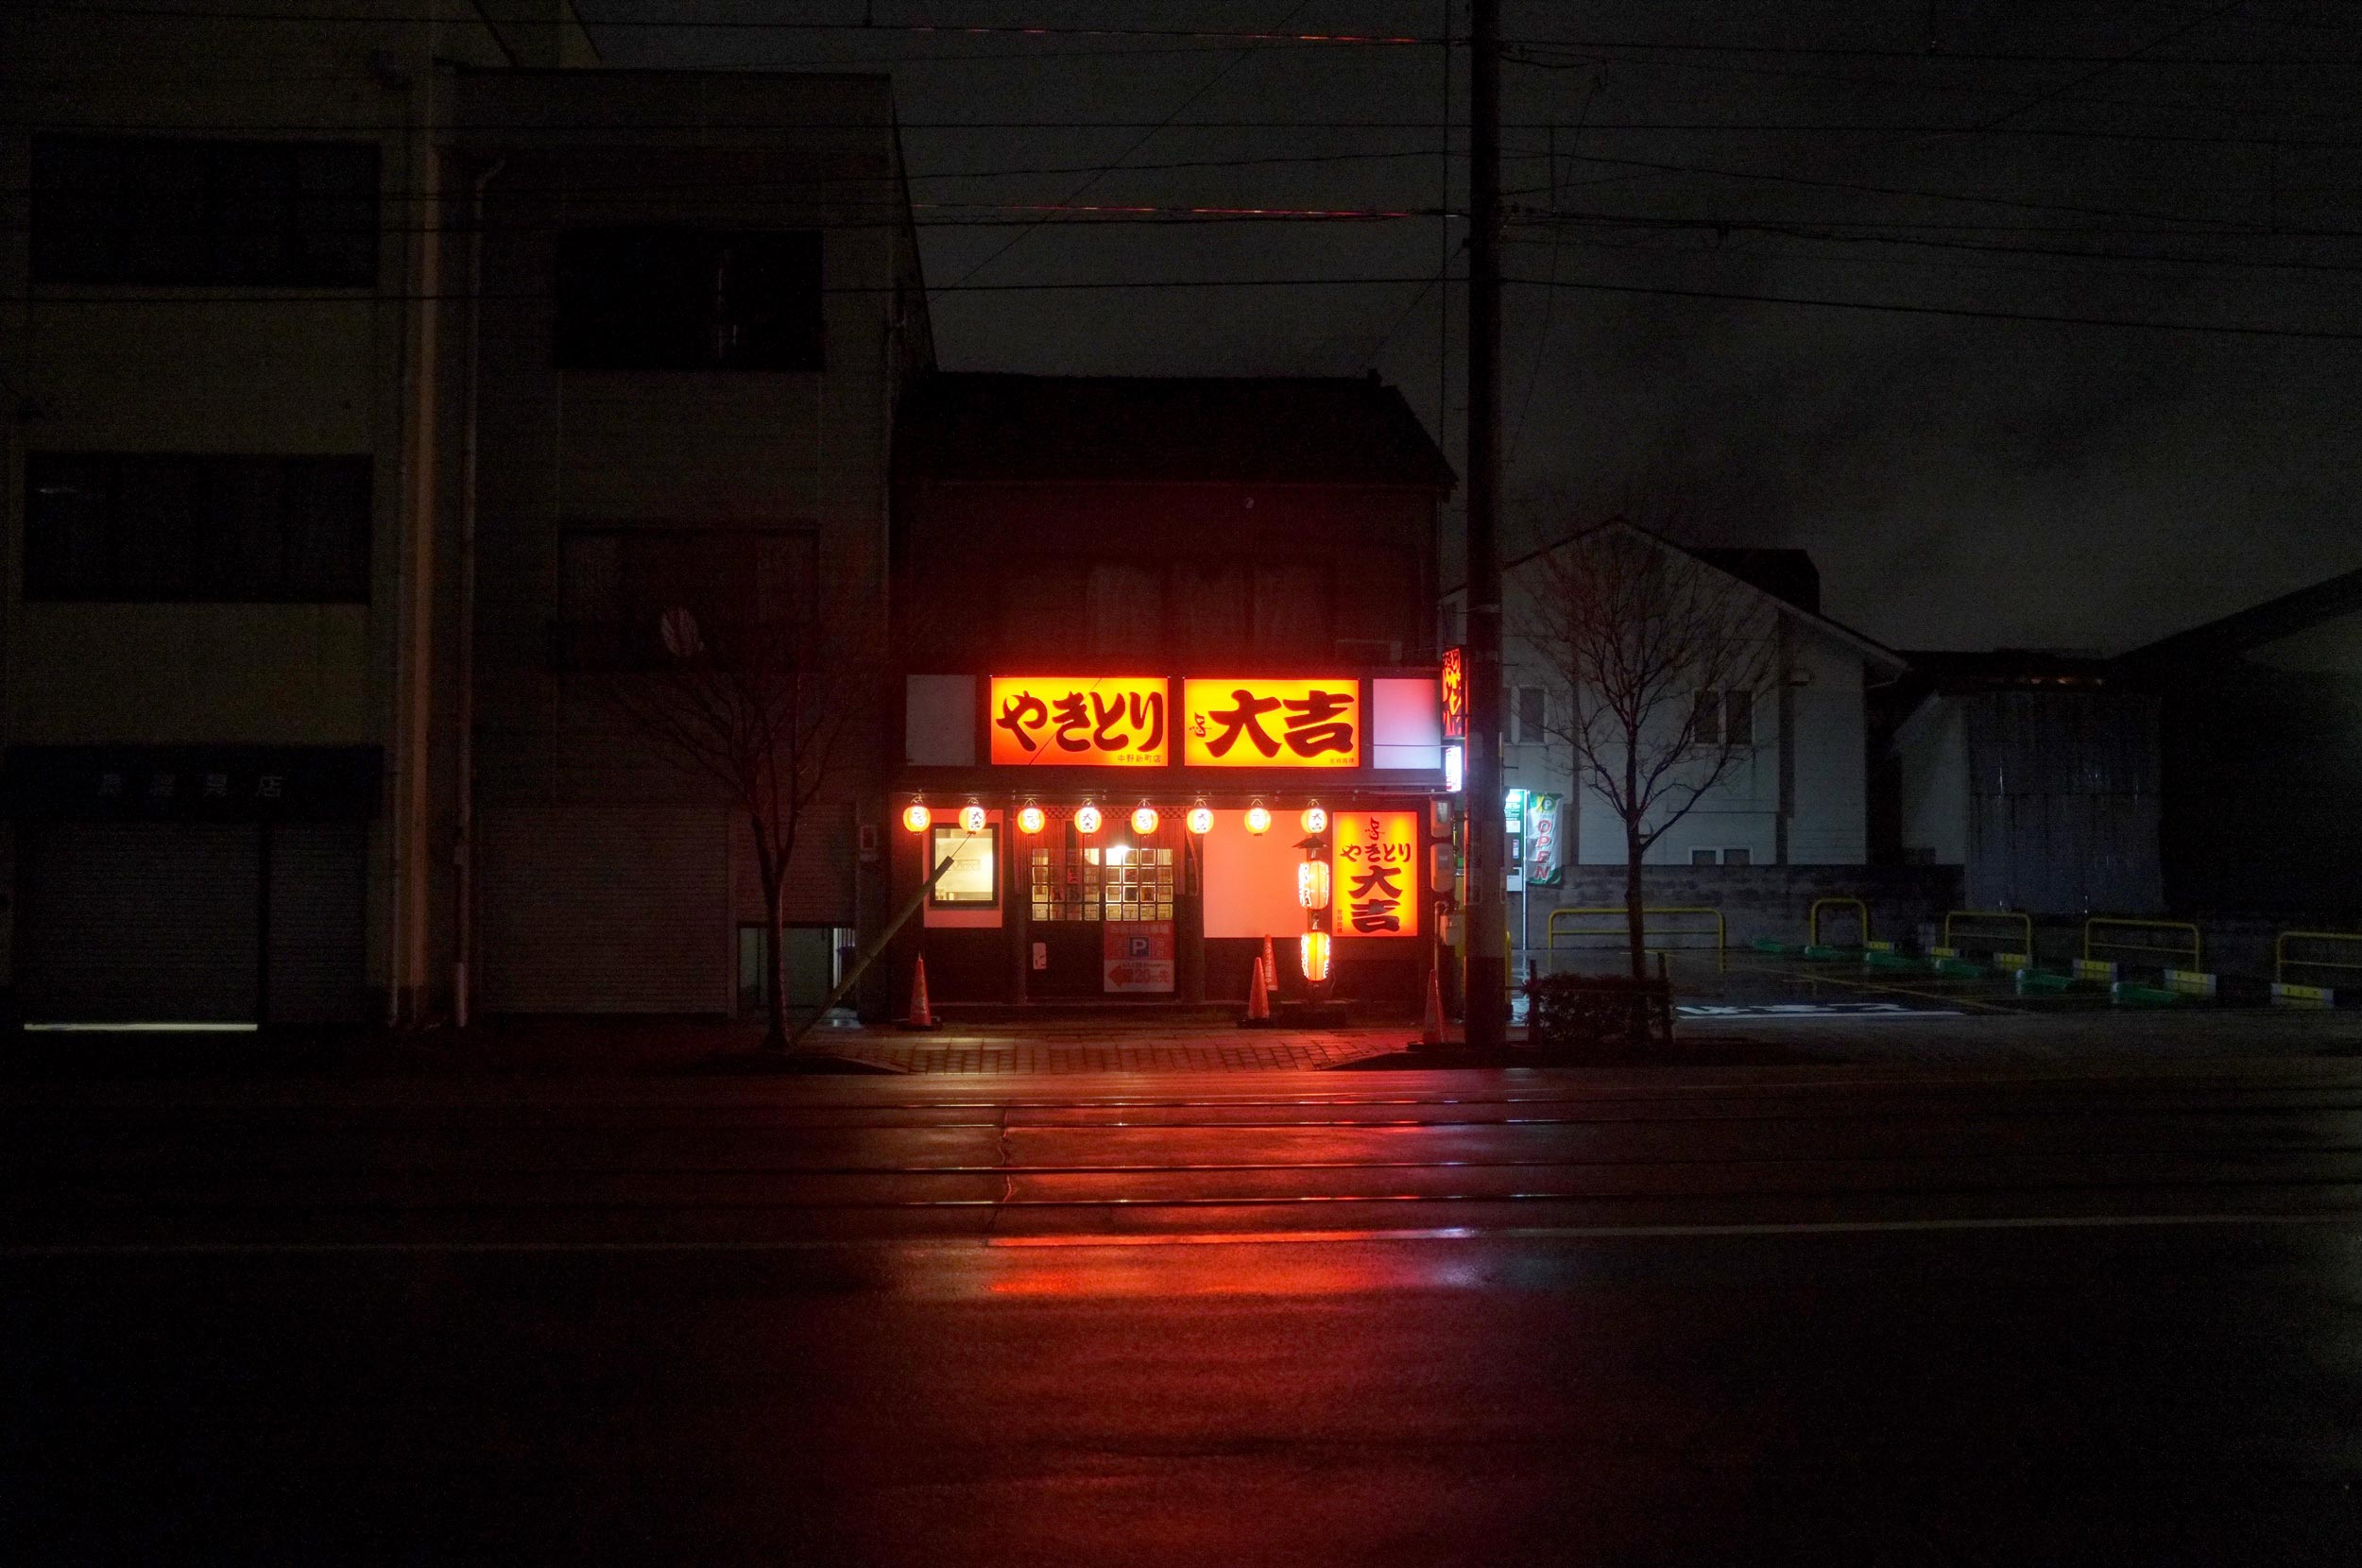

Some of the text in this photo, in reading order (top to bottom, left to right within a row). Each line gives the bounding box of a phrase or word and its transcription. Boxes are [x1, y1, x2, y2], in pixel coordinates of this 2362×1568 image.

[996, 690, 1163, 752] やきとり
[1205, 690, 1354, 758] 大吉
[1340, 844, 1411, 862] やきとり
[1534, 819, 1552, 879] OPEN
[1348, 865, 1403, 933] 大吉
[1132, 938, 1148, 955] P
